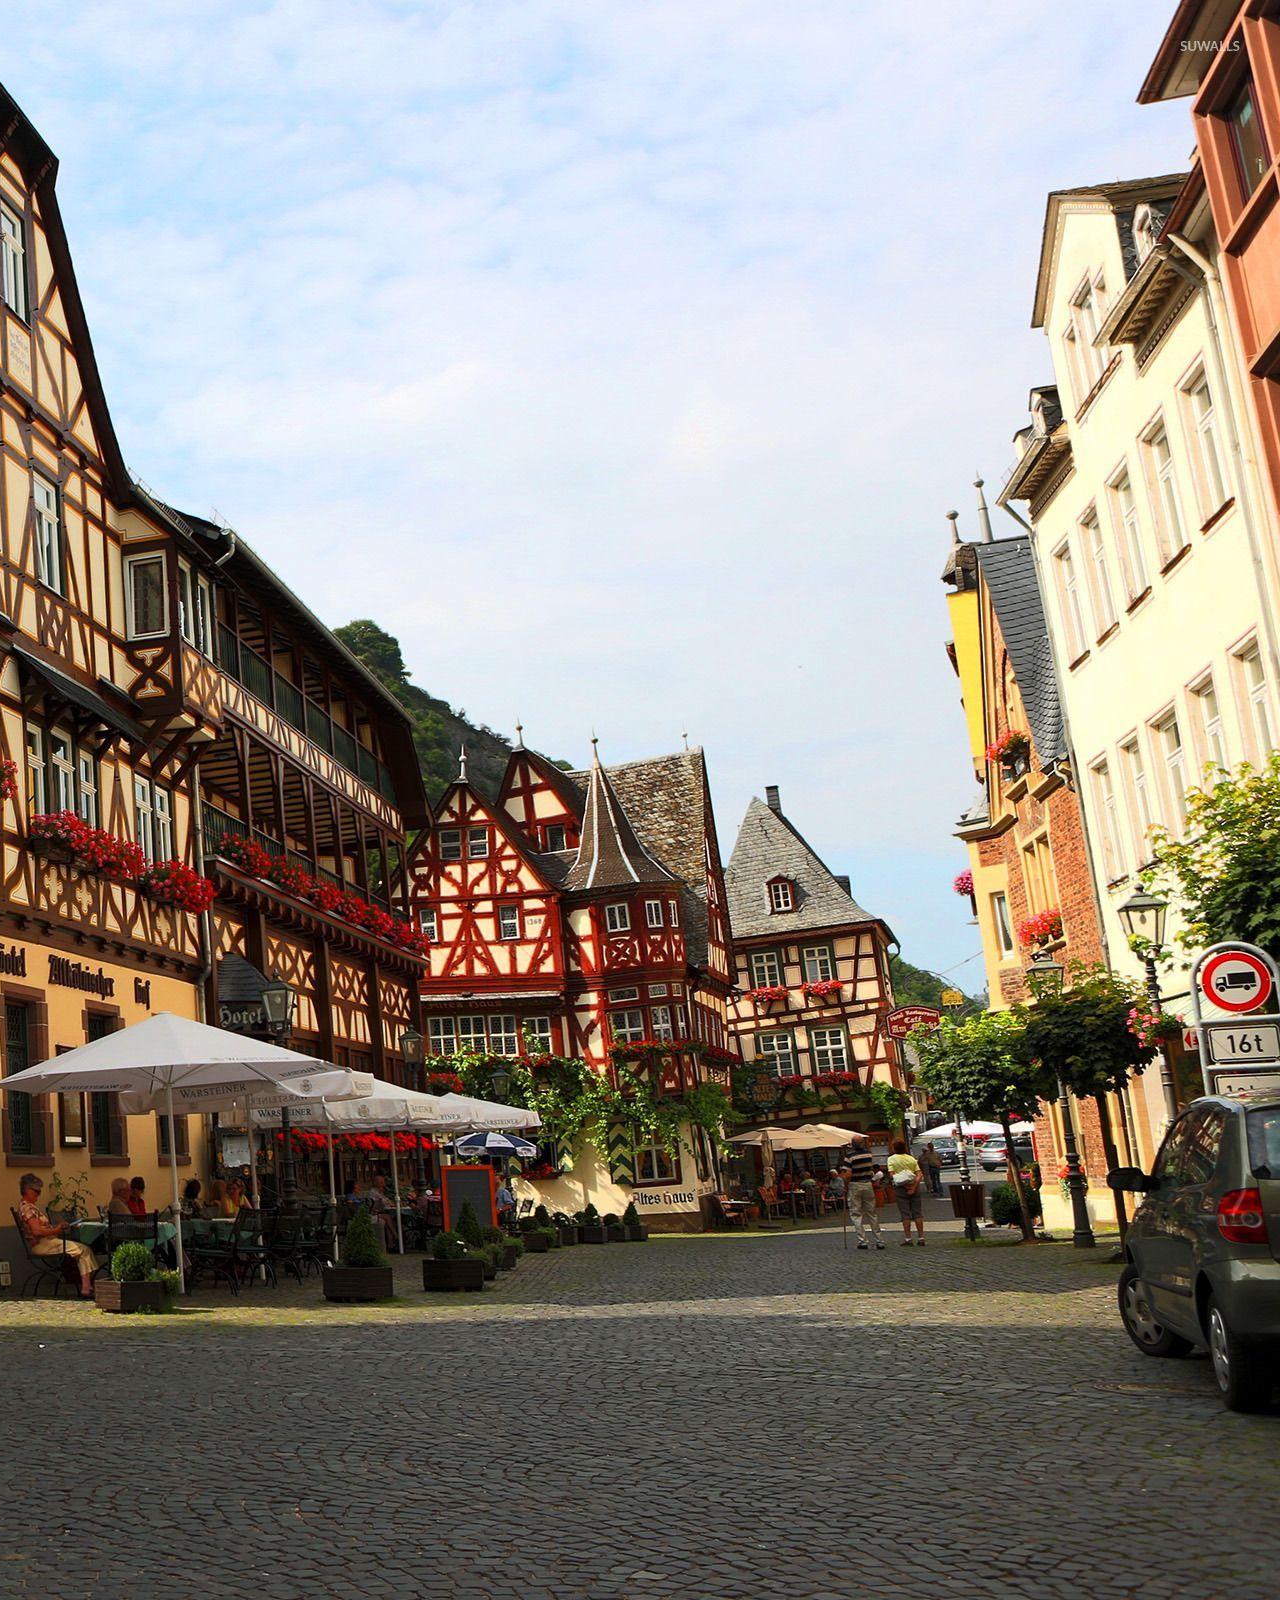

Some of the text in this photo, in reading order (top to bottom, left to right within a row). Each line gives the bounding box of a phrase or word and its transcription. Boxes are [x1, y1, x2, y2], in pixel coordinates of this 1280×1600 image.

[220, 1005, 264, 1028] Hotel
[179, 1083, 247, 1099] WARSTEINER
[257, 1107, 312, 1118] WARSEINER
[632, 1191, 661, 1205] Altes
